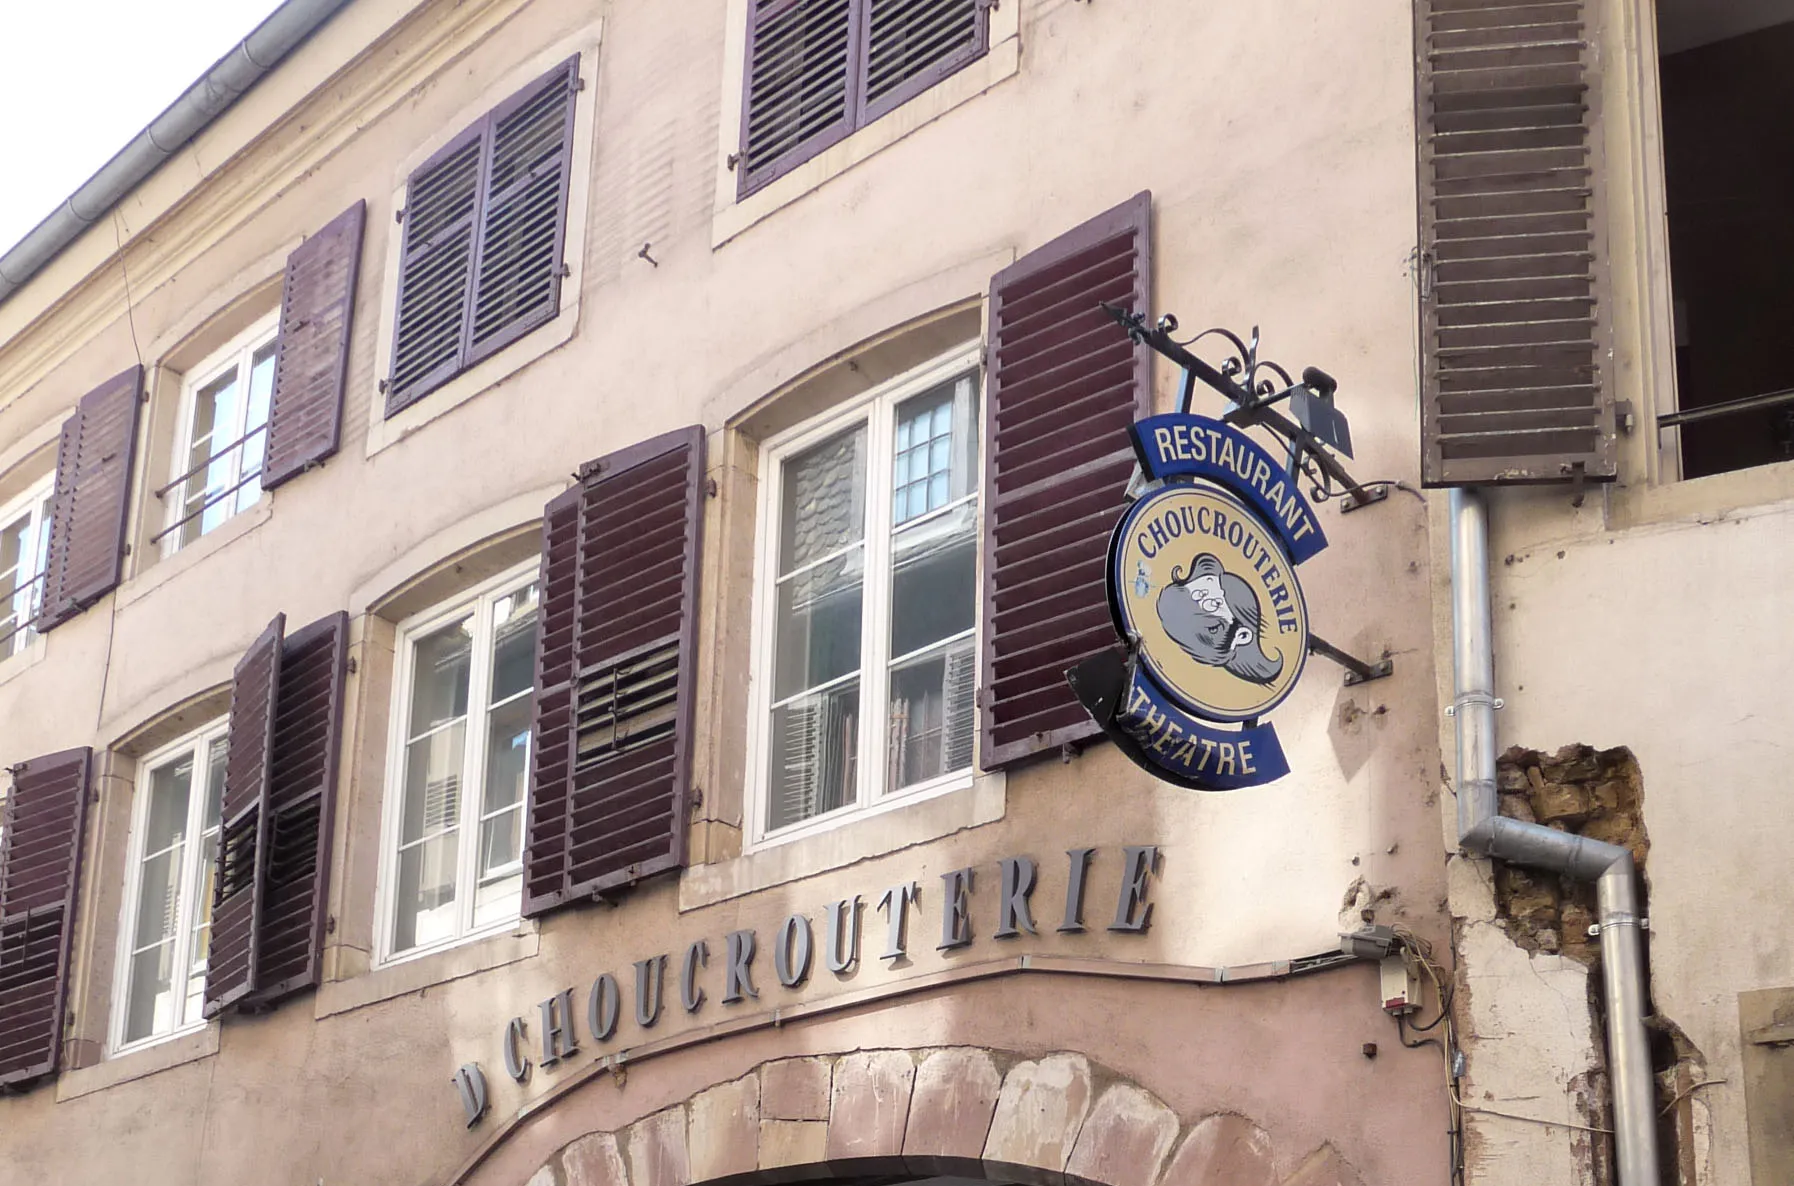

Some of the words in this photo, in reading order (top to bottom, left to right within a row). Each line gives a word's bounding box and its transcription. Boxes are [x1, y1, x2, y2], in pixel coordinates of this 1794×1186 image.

[1154, 425, 1314, 542] RESTAURANT
[1137, 505, 1298, 635] CHOUCROUTERIE
[1130, 686, 1257, 776] THEATRE
[503, 846, 1160, 1083] CHOUCROUTERIE
